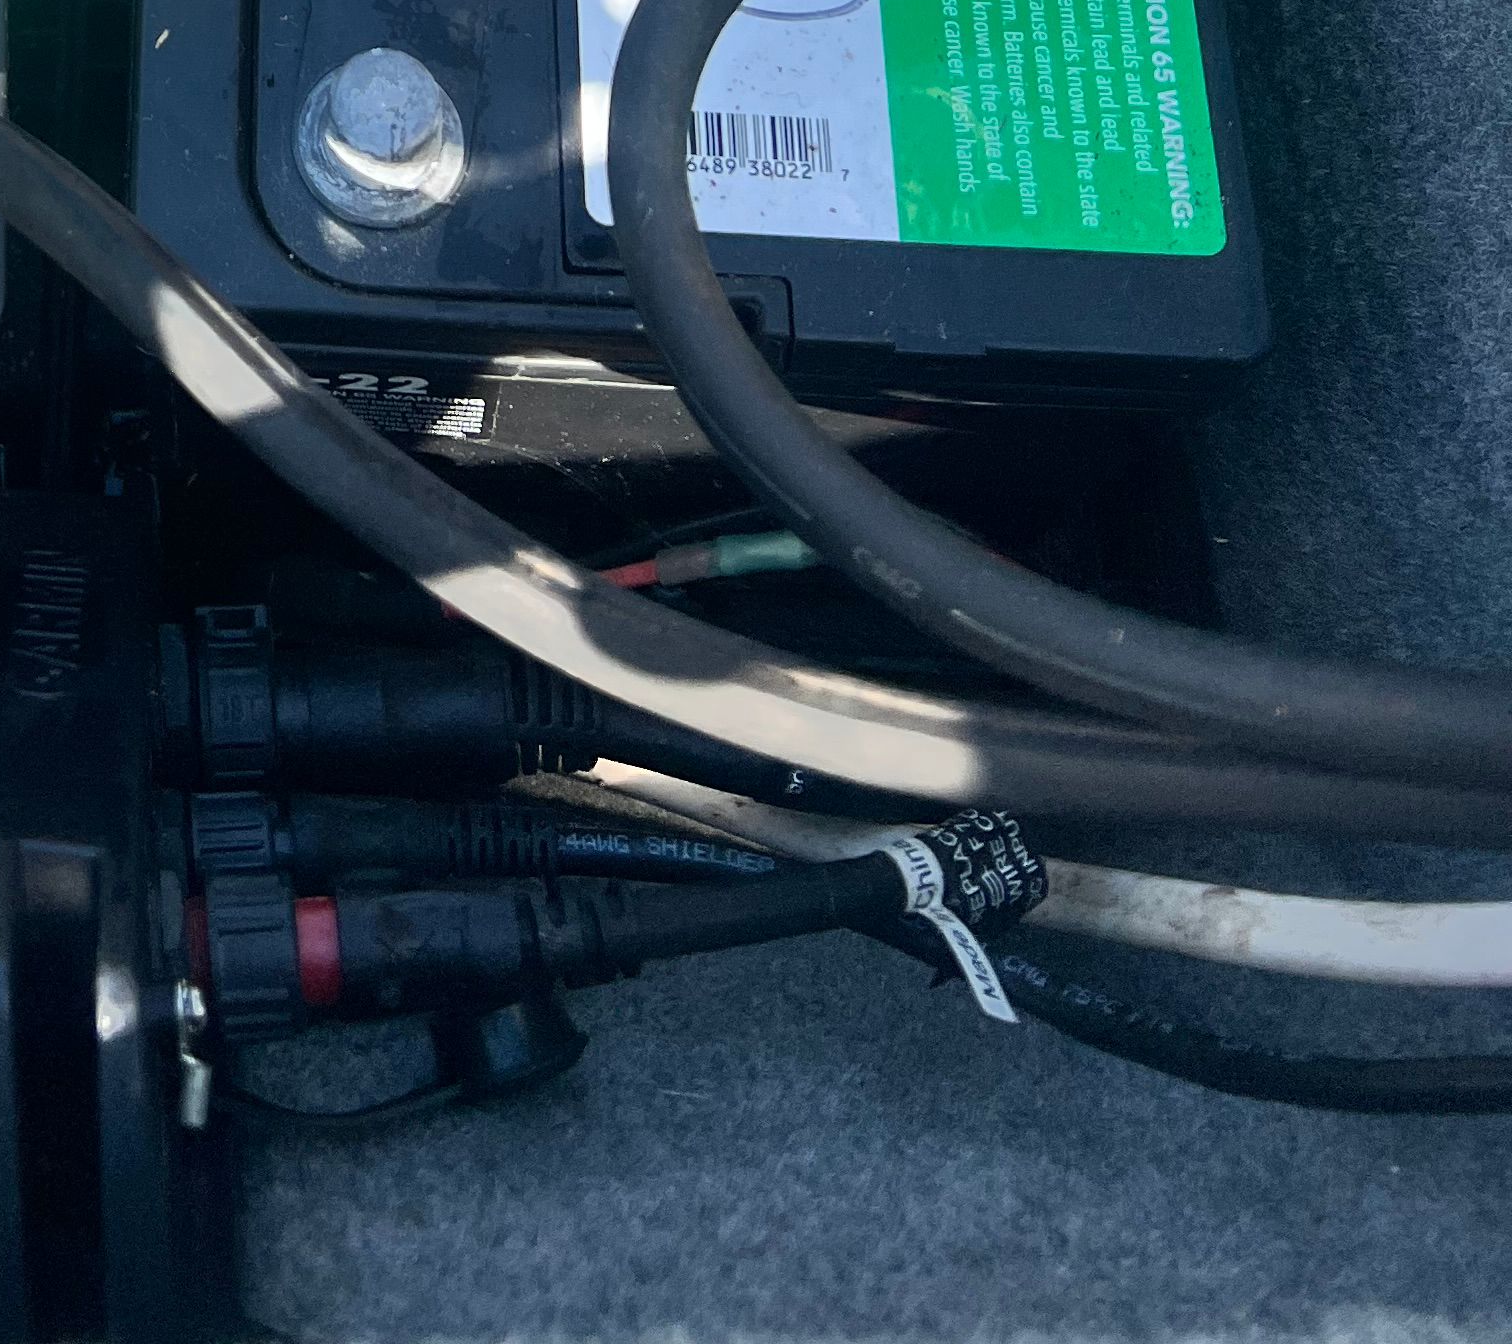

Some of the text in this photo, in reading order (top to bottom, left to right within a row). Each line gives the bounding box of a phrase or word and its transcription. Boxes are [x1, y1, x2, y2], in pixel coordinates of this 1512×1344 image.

[972, 1, 993, 59] known
[1003, 31, 1027, 108] Batteries
[1091, 34, 1116, 71] lead
[1151, 50, 1177, 83] 65
[978, 63, 996, 80] to
[1034, 45, 1057, 102] cancer
[1125, 72, 1150, 106] and
[950, 85, 976, 133] Wash
[979, 84, 1002, 113] the
[1067, 67, 1088, 124] known
[1096, 75, 1121, 108] and
[983, 116, 1005, 160] state
[1011, 109, 1035, 146] also
[1041, 105, 1065, 140] and
[1073, 129, 1090, 146] to
[1101, 114, 1126, 151] lead
[1131, 111, 1160, 173] related
[1157, 89, 1194, 229] WARNING:
[747, 159, 850, 182] 38022 7
[956, 138, 981, 193] hands
[987, 162, 1011, 182] of
[1015, 149, 1038, 216] contain
[1075, 151, 1096, 181] the
[1080, 184, 1100, 227] state
